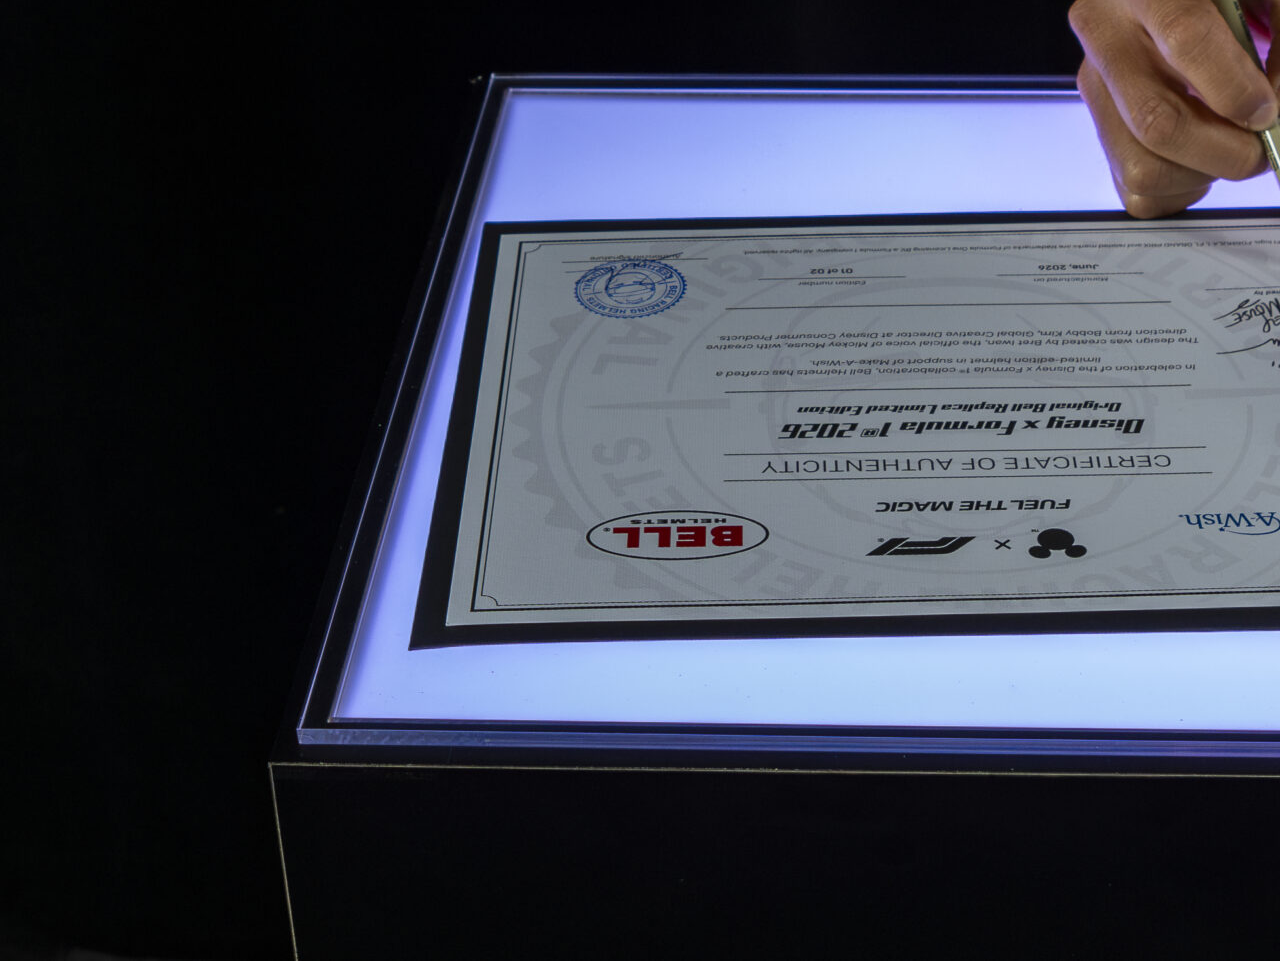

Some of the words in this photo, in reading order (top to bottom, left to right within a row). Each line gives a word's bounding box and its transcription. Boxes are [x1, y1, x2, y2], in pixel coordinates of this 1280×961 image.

[1068, 263, 1100, 271] June,
[774, 333, 836, 341] Consumer
[839, 331, 878, 340] Disney
[896, 331, 943, 339] Director
[1066, 329, 1102, 337] Bobby
[1104, 329, 1132, 337] from
[784, 341, 826, 349] Mouse,
[828, 341, 868, 349] Mickey
[1018, 339, 1042, 347] Bret
[1136, 337, 1175, 345] design
[810, 359, 890, 367] Make-A-Wish.
[907, 357, 954, 365] support
[970, 357, 1012, 365] helmet
[875, 367, 956, 375] collaboration,
[1035, 365, 1075, 373] Disney
[1078, 365, 1097, 373] the
[1100, 365, 1112, 373] of
[1115, 364, 1182, 372] celebration
[1185, 363, 1196, 371] In
[772, 369, 794, 377] has
[796, 405, 863, 416] Edition
[865, 404, 937, 414] Limited
[941, 401, 1009, 413] Replica
[1011, 403, 1046, 413] Bell
[1048, 401, 1122, 412] Original
[899, 420, 1017, 436] Formula
[1022, 419, 1041, 429] x
[1045, 416, 1145, 434] Disney
[778, 423, 858, 439] 2026
[761, 458, 952, 473] AUTHENTICITY
[961, 457, 996, 471] OF
[1004, 454, 1171, 470] CERTIFICATE
[875, 501, 954, 512] MAGIC
[959, 500, 1007, 511] THE
[1010, 499, 1071, 510] FUEL
